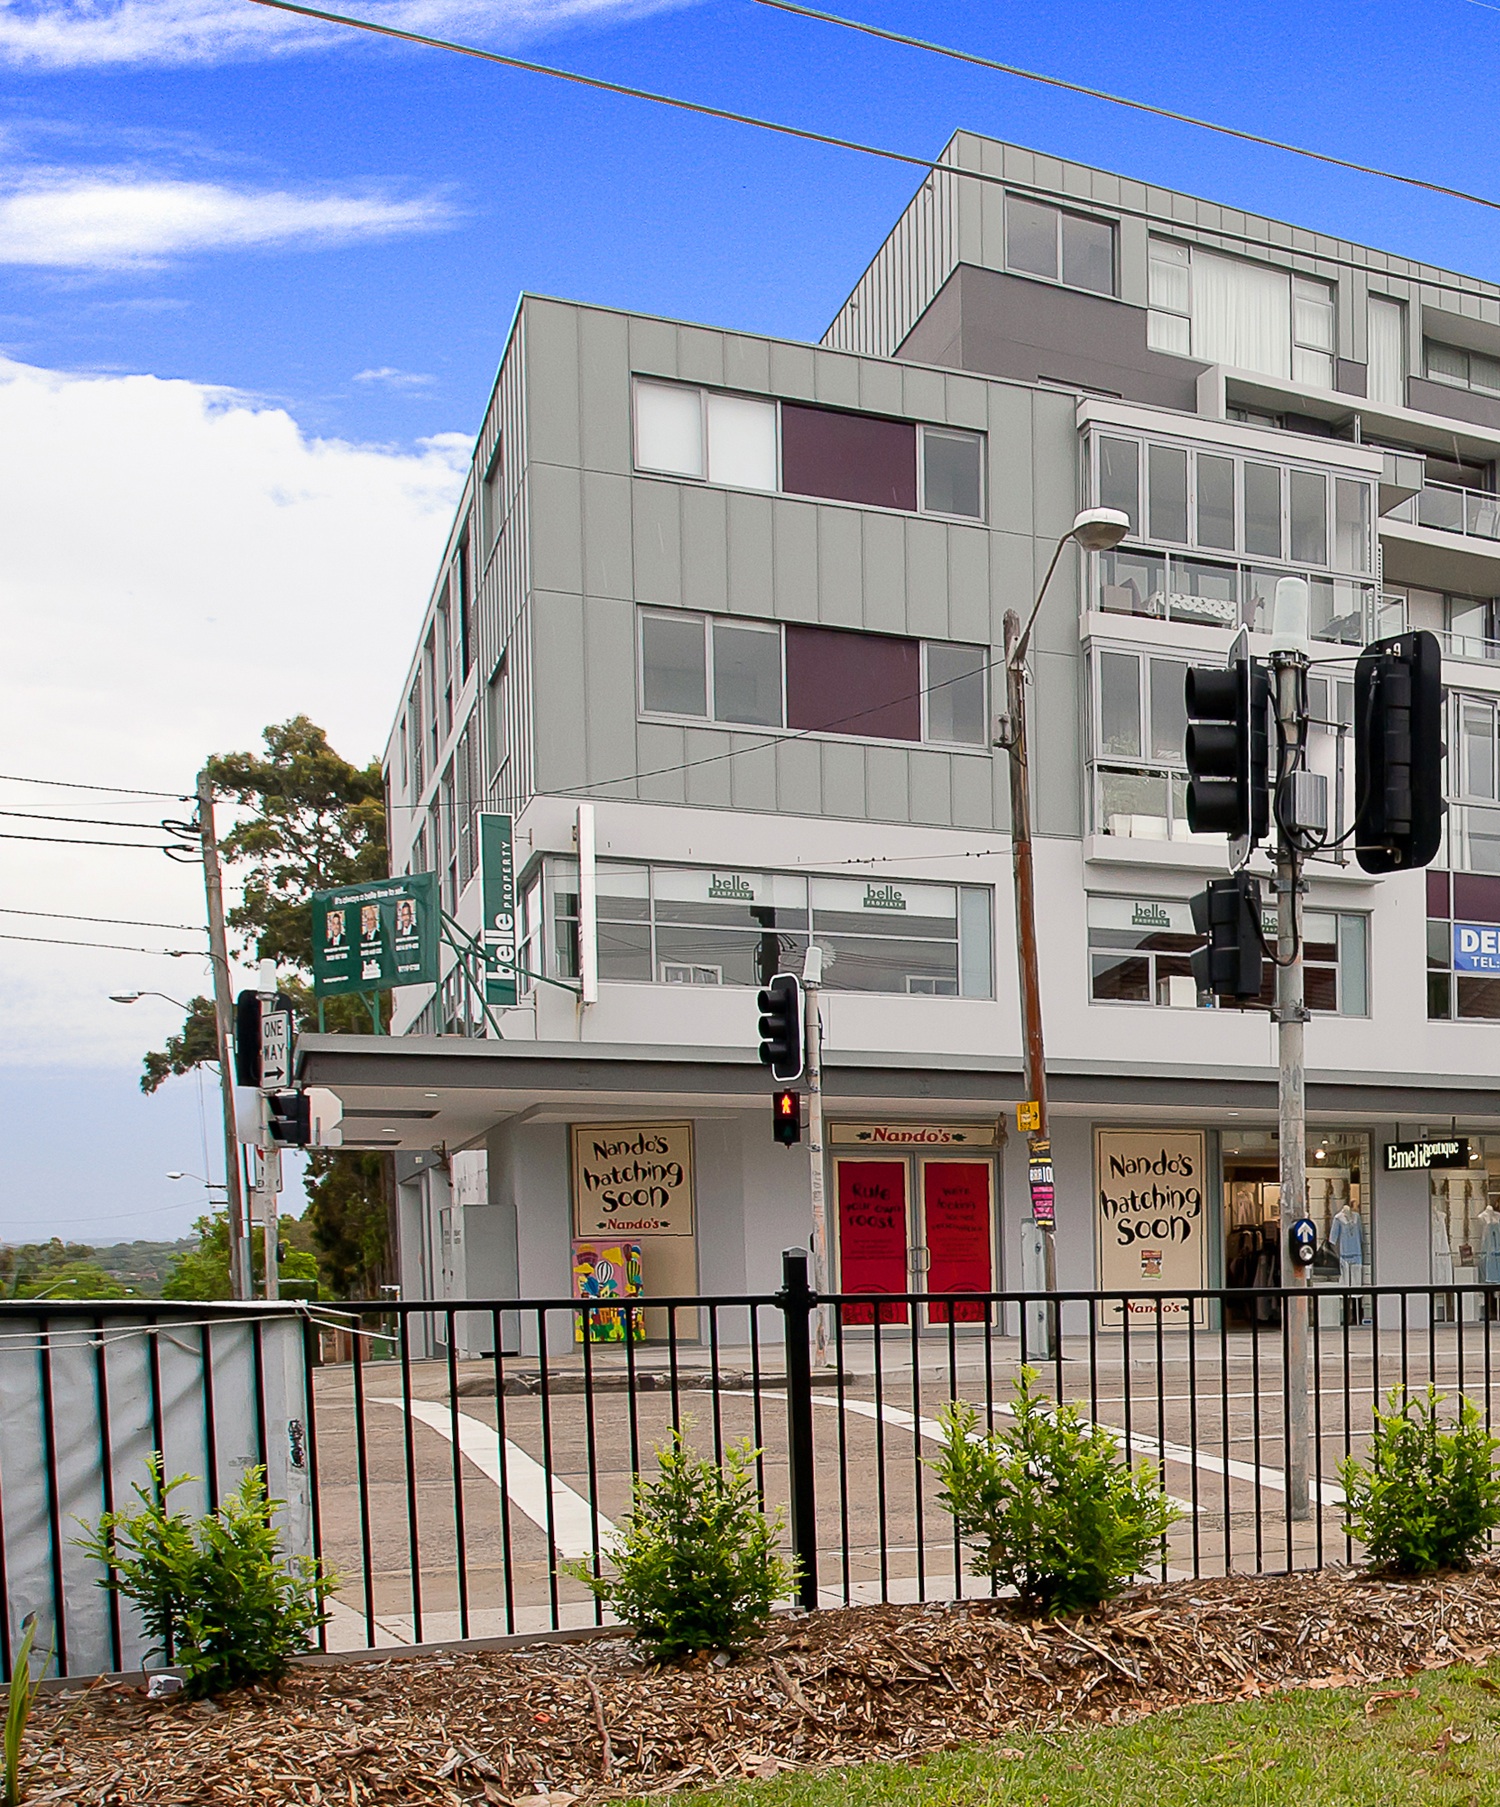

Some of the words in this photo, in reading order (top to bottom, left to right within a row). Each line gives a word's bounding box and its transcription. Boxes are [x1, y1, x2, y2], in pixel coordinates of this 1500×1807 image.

[501, 841, 513, 909] PROPERTY
[712, 874, 750, 890] belle
[711, 889, 751, 899] PROPERTY
[866, 884, 902, 901] belle
[1135, 903, 1167, 918] belle
[485, 912, 515, 980] belle
[1471, 956, 1500, 968] TEL:
[264, 1019, 284, 1038] ONE
[263, 1043, 285, 1061] WAY
[871, 1127, 950, 1143] Nando's
[593, 1132, 669, 1161] Nando's
[1109, 1148, 1194, 1179] Nando's
[583, 1160, 683, 1192] hatching
[602, 1186, 670, 1213] soon
[852, 1183, 890, 1201] Rule
[1099, 1183, 1201, 1220] hatching
[607, 1217, 660, 1230] Nando's
[848, 1214, 896, 1229] roost
[1117, 1215, 1191, 1246] soon
[1126, 1301, 1180, 1314] Nano's
